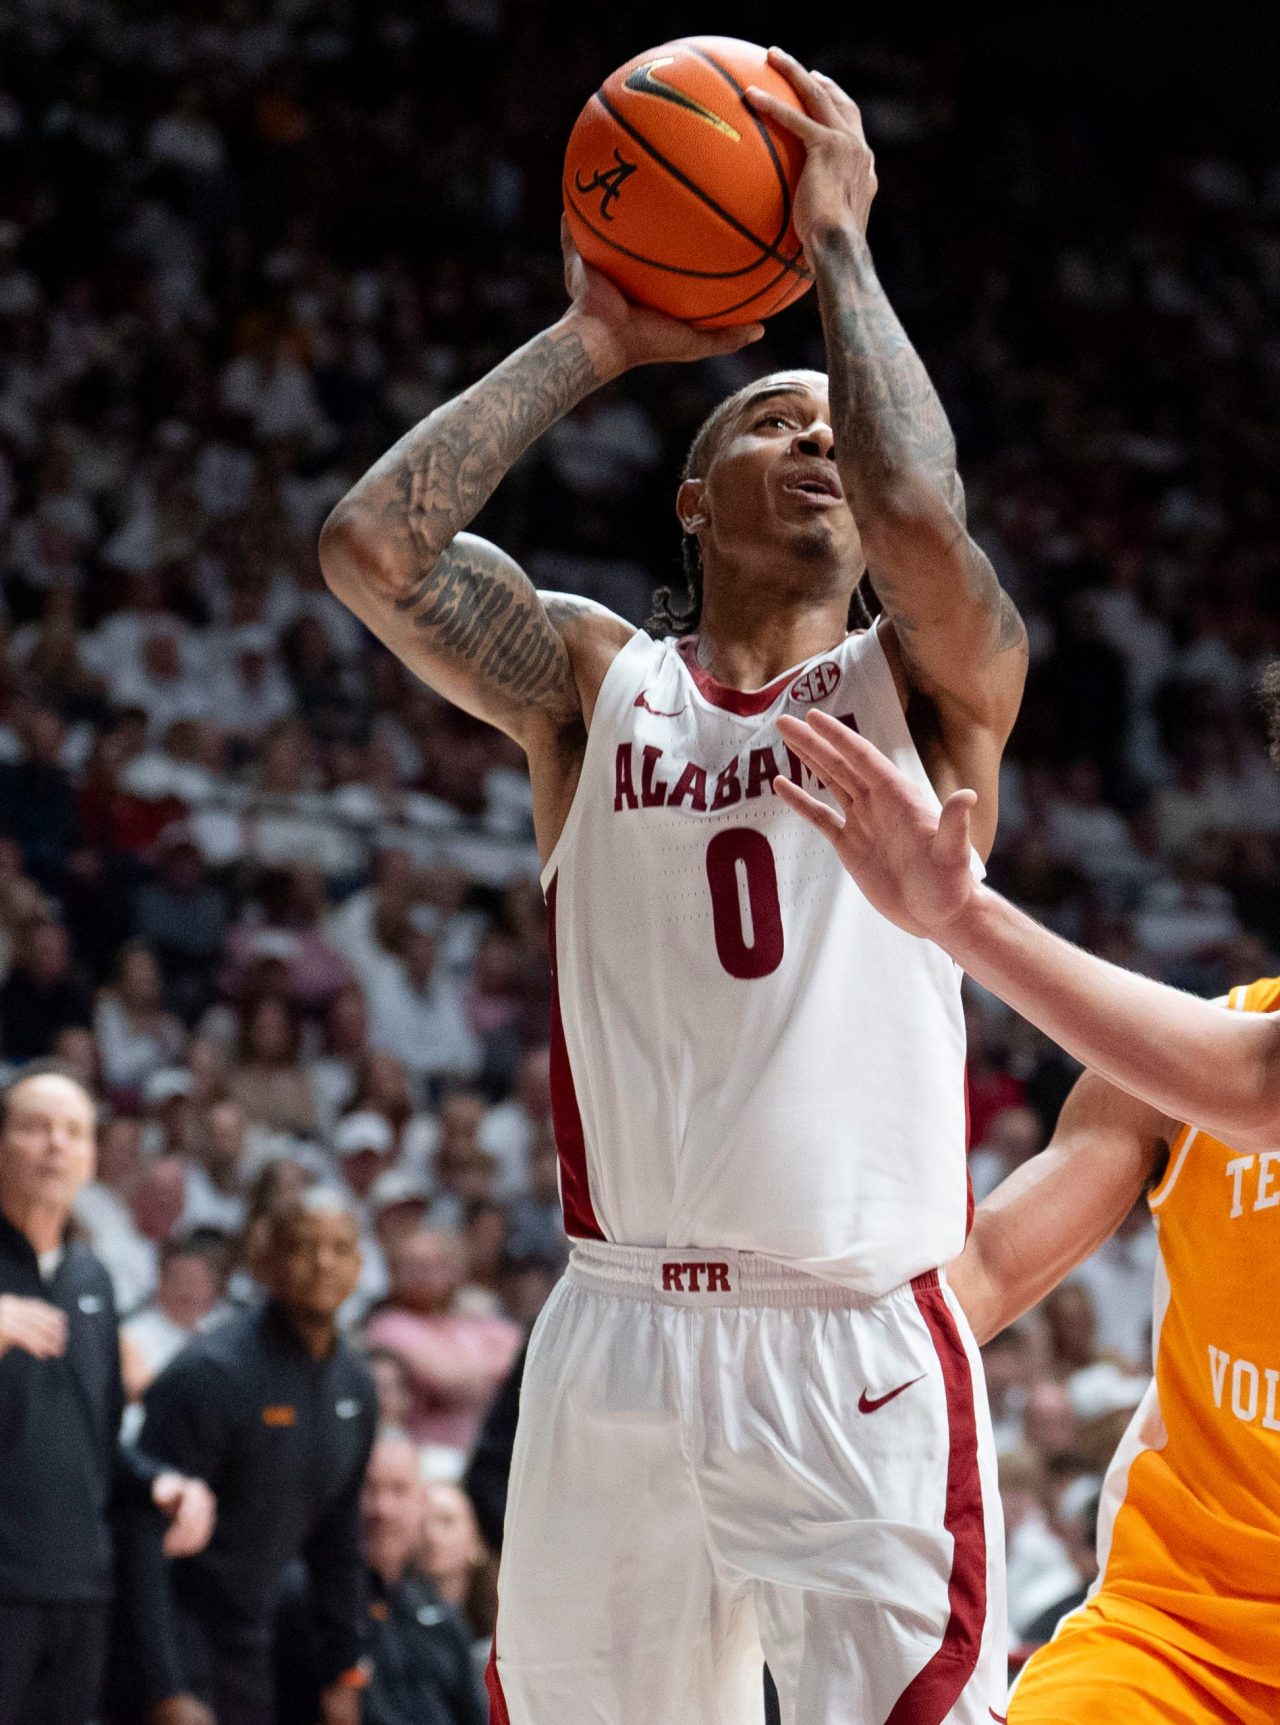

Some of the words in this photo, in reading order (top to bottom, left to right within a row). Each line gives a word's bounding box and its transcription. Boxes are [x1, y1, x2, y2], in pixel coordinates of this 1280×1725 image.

[575, 148, 637, 221] A
[792, 662, 841, 703] SEC
[614, 713, 860, 812] ALABA
[706, 827, 784, 979] 0
[662, 1262, 731, 1292] RTR
